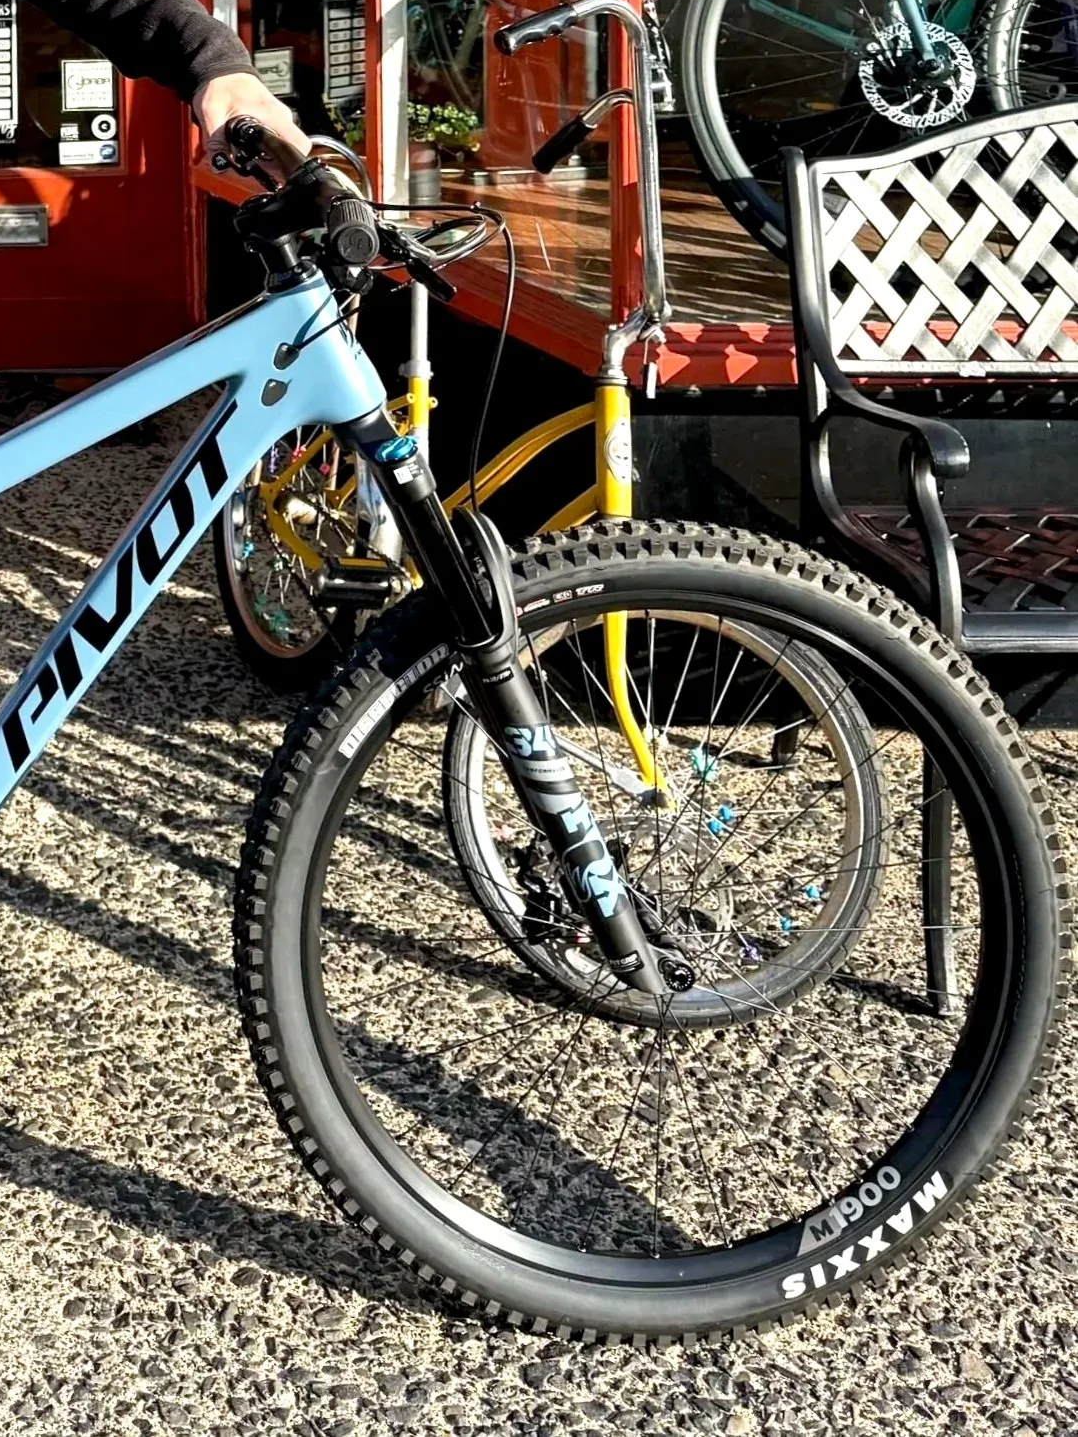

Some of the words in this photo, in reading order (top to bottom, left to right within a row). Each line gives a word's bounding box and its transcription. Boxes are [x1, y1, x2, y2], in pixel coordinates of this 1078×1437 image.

[1, 399, 239, 774] PIVOT
[338, 642, 450, 760] DISSECTOR
[555, 798, 629, 919] FOX
[781, 1169, 949, 1301] MAXXIS
[809, 1165, 902, 1243] M1900
